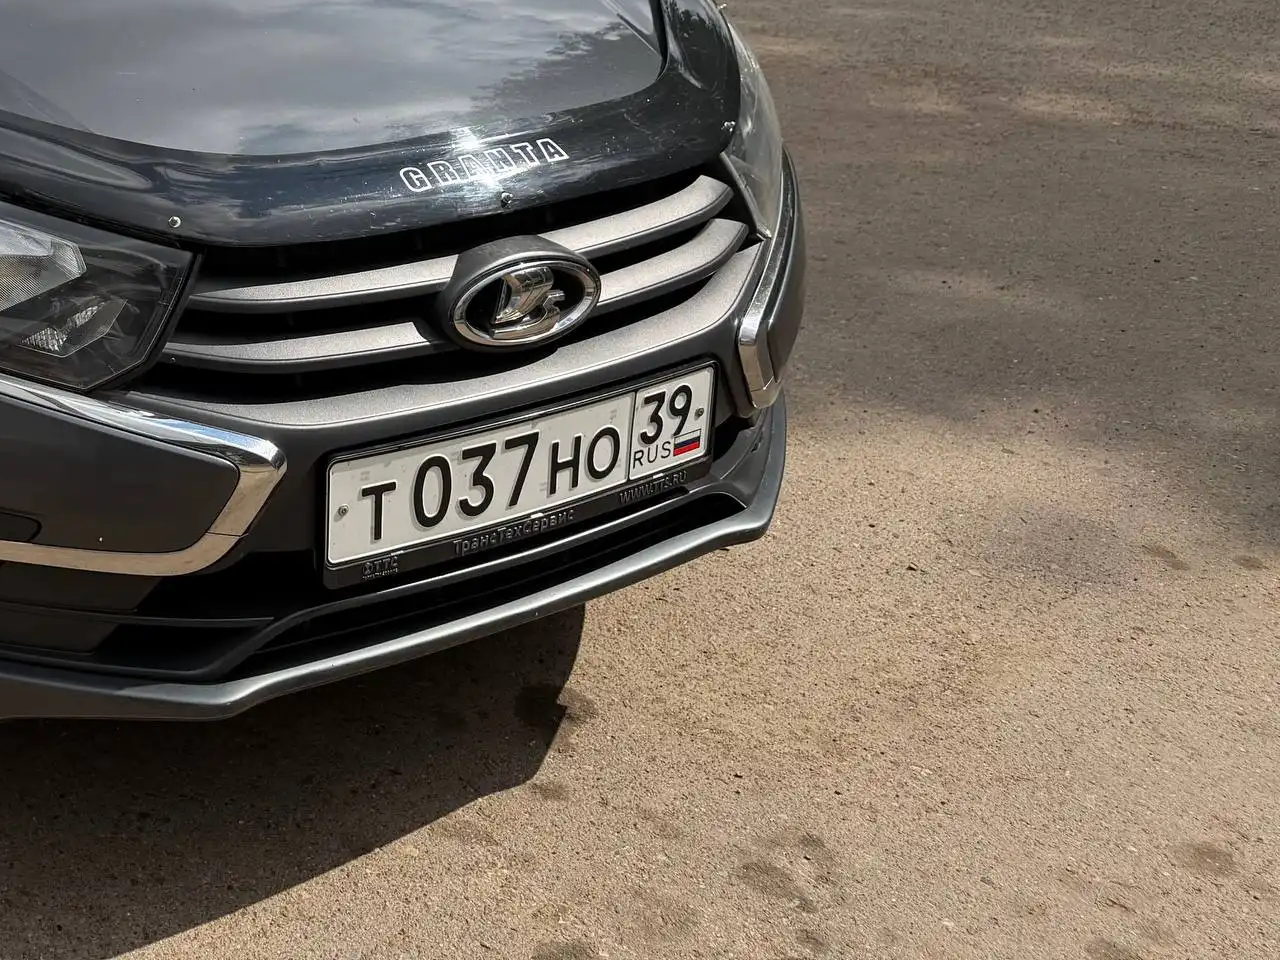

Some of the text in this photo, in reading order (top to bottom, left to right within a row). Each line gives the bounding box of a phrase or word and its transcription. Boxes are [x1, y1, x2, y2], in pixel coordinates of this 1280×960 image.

[399, 138, 570, 192] GRANTA
[361, 385, 693, 541] Т037НО 39
[632, 441, 671, 469] RUS
[453, 510, 575, 556] ТрансТехСервис
